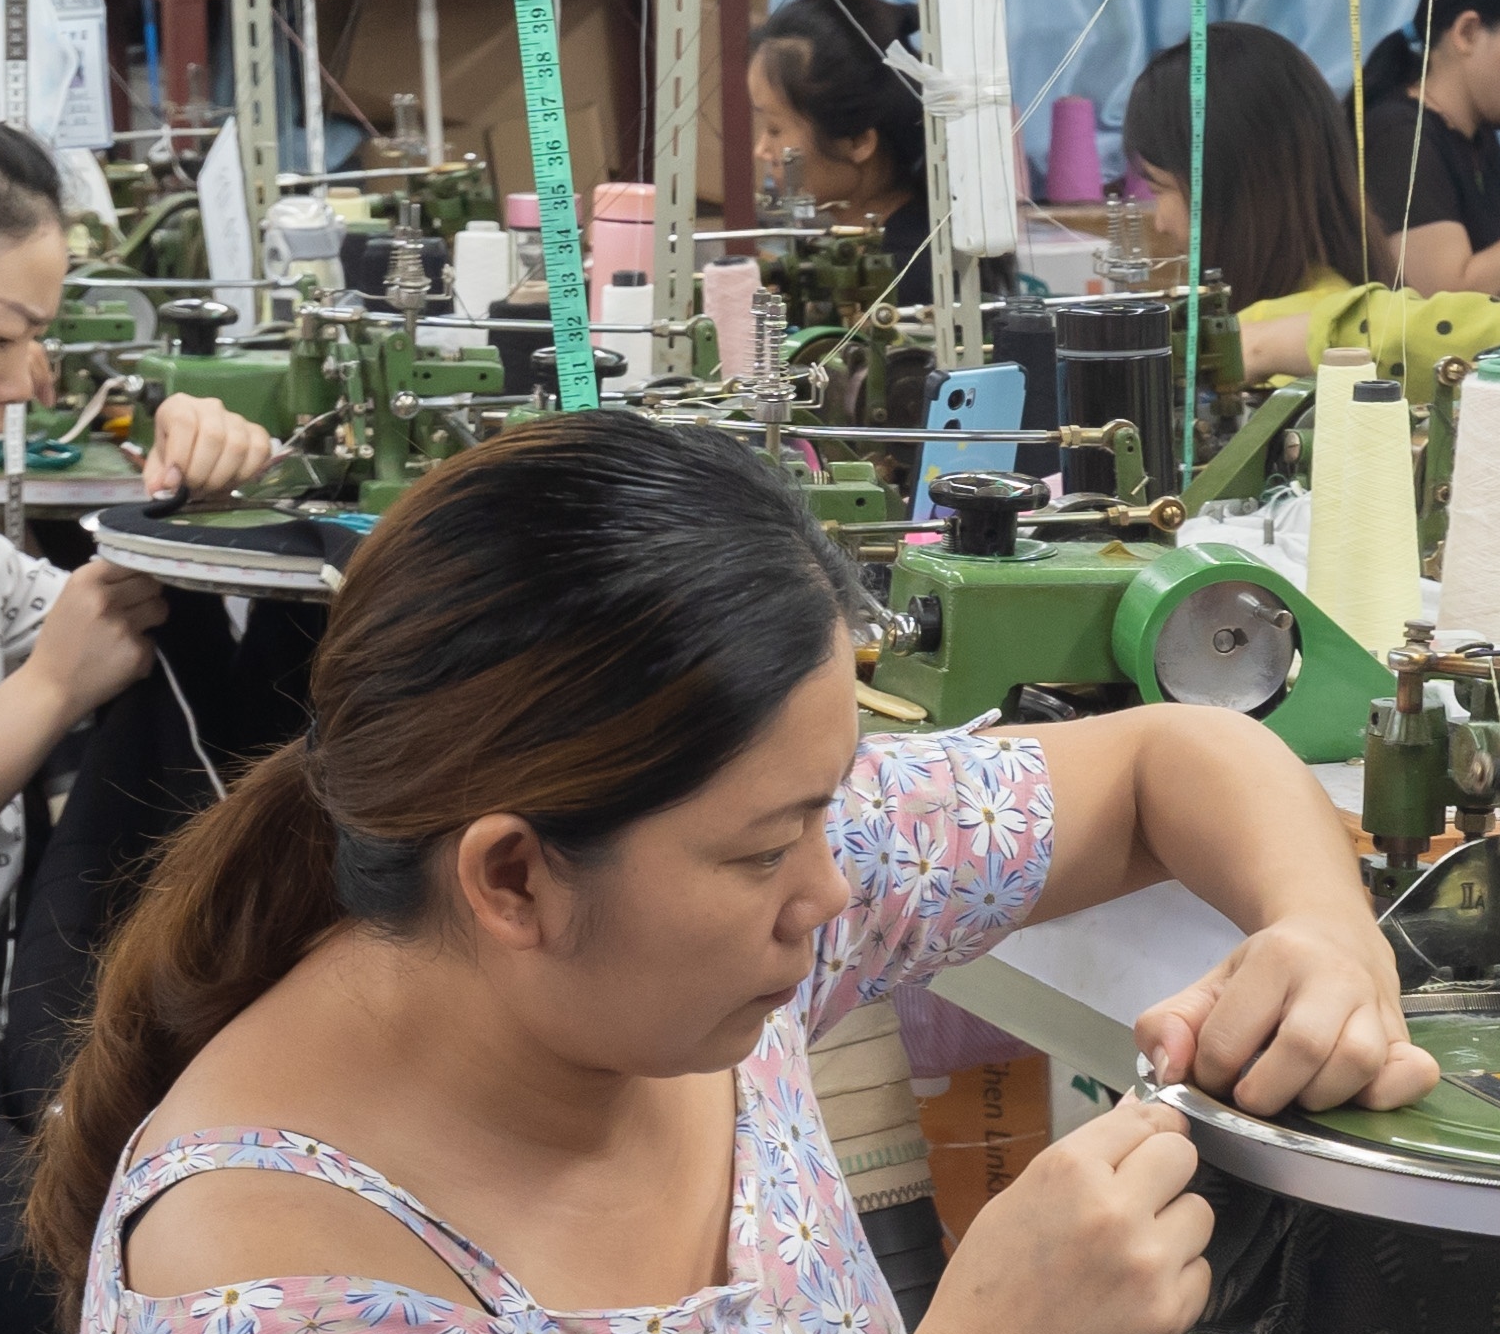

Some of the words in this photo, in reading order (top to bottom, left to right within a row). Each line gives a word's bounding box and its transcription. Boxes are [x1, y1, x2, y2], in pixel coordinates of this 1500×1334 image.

[531, 8, 548, 33] 39
[536, 51, 553, 78] 38
[541, 97, 558, 122] 37
[545, 140, 563, 165] 36
[551, 184, 568, 209] 35
[557, 228, 573, 254] 34
[562, 272, 578, 298] 33
[567, 316, 583, 341] 32
[573, 361, 589, 385] 31
